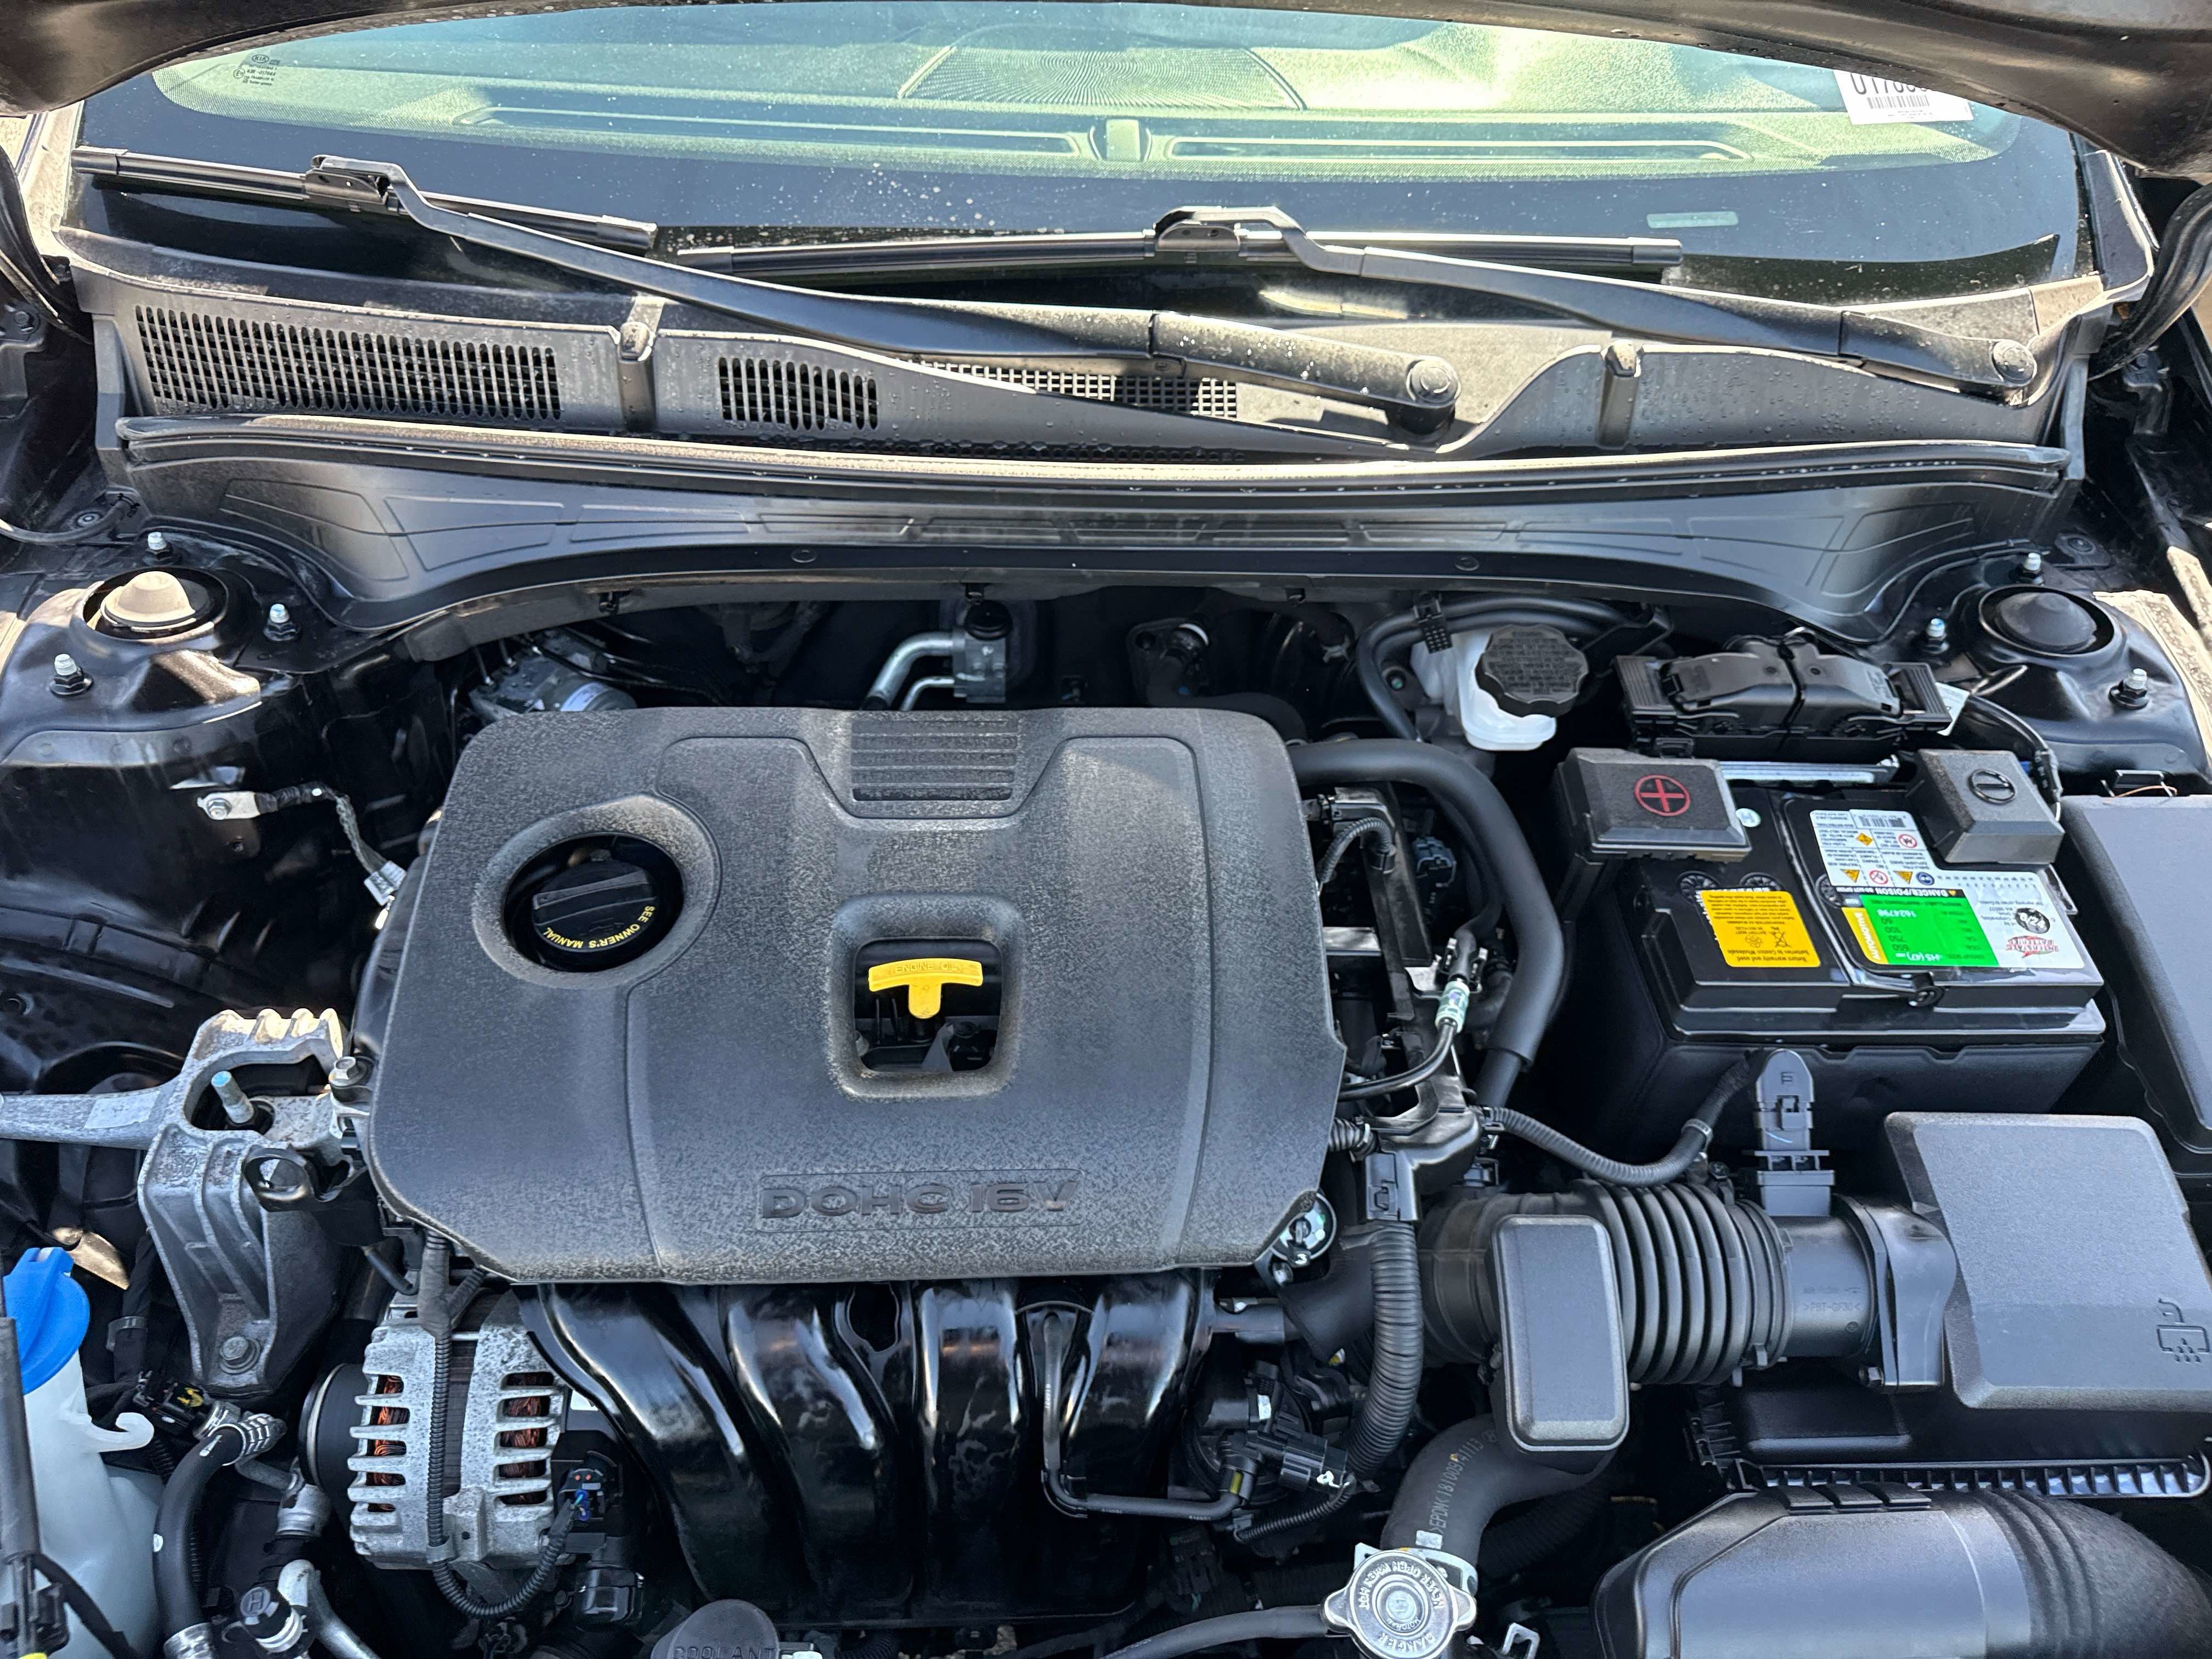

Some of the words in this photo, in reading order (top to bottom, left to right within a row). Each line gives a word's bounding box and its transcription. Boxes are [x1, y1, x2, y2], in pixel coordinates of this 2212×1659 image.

[1875, 888, 1947, 896] DANGER/POISON
[637, 905, 655, 923] SEE
[544, 926, 584, 949] MANUAL
[588, 923, 641, 949] OWNER'S
[1853, 911, 1881, 960] AUTOMOTIVE
[2006, 944, 2058, 952] INTERSTATE
[895, 962, 934, 974] ENGINE
[940, 962, 957, 970] OIL
[762, 1182, 950, 1219] DOHC
[968, 1180, 1080, 1214] 16V
[1377, 1632, 1435, 1652] DANGER
